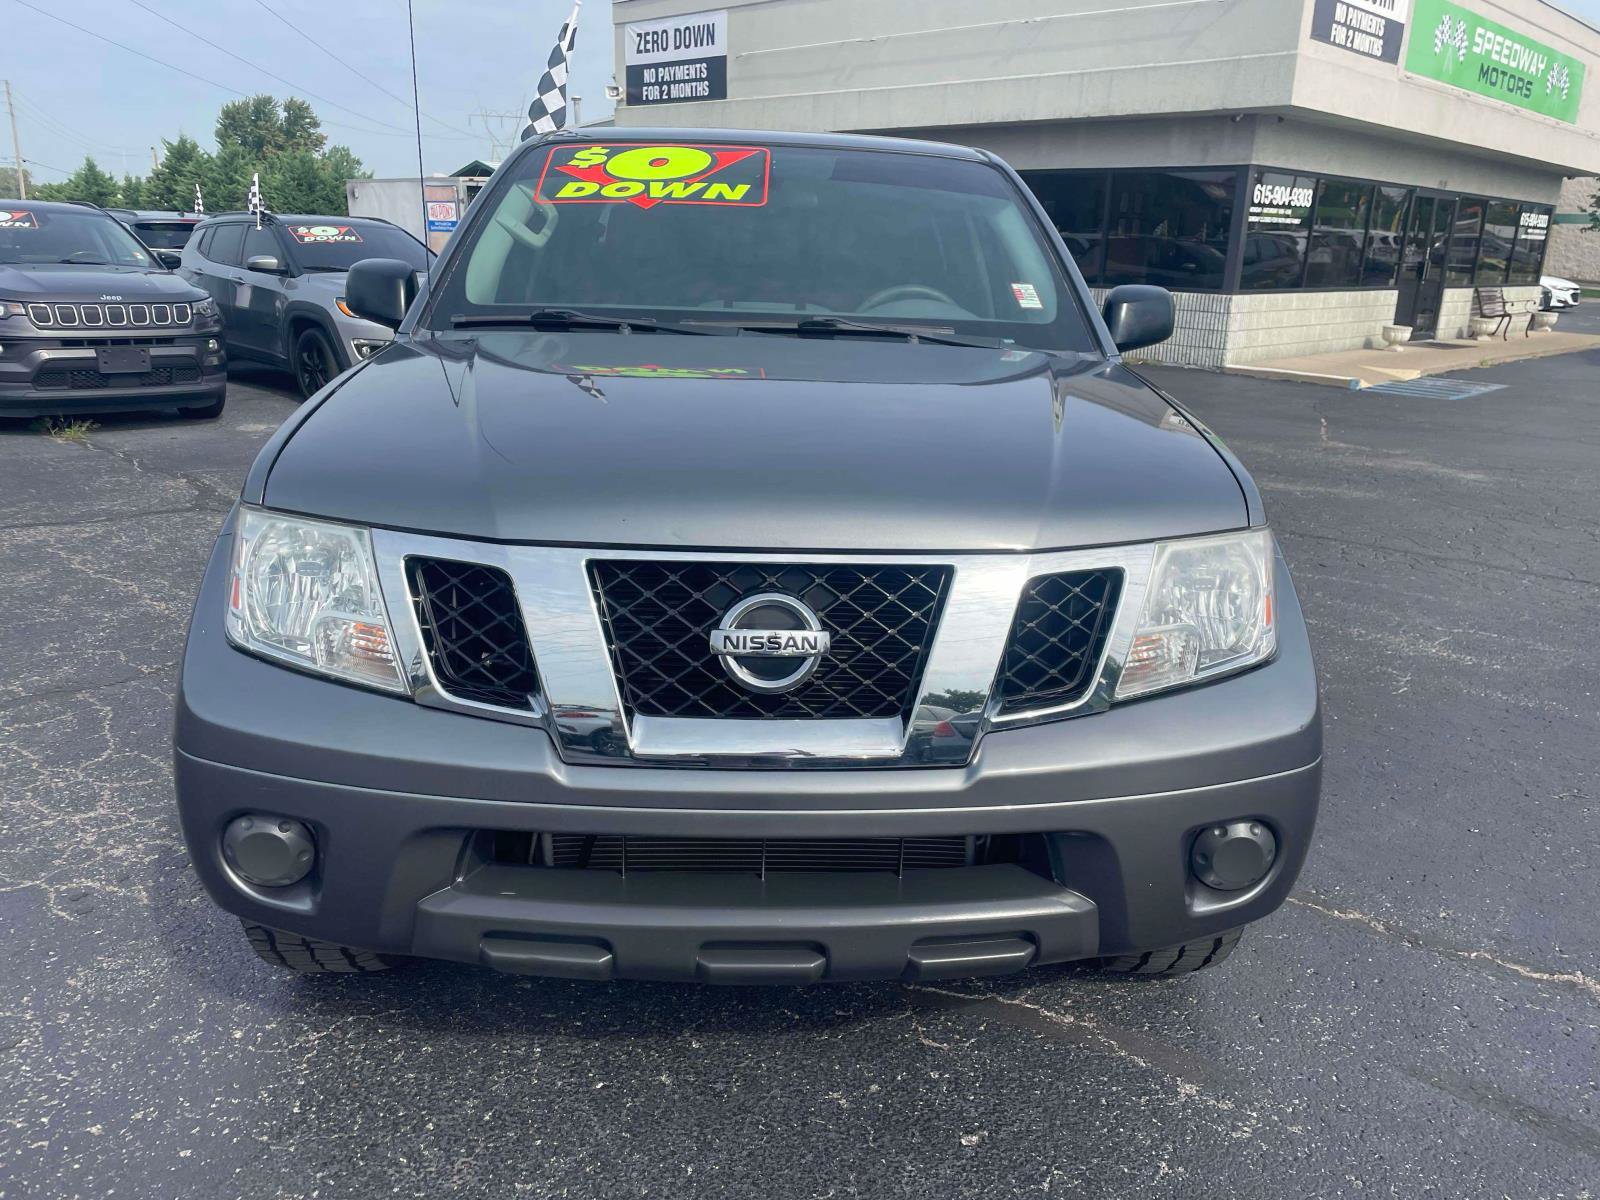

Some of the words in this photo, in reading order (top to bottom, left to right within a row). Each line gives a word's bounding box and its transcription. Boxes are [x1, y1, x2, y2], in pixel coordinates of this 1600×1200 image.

[1334, 2, 1347, 23] NO
[1346, 7, 1386, 37] PAYMENTS
[636, 29, 669, 54] ZERO
[674, 23, 715, 50] DOWN
[1330, 23, 1347, 46] FOR
[1345, 30, 1354, 48] 2
[1352, 31, 1384, 57] MONTHS
[1472, 27, 1548, 78] SPEEDWAY
[643, 68, 656, 84] NO
[658, 63, 708, 82] PAYMENTS
[1478, 63, 1533, 99] MOTORS
[642, 86, 661, 100] FOR
[662, 84, 669, 99] 2
[670, 81, 709, 99] MONTHS
[567, 146, 712, 181] $0
[555, 181, 751, 200] DOWN
[1253, 184, 1313, 207] 615-904-9303
[723, 635, 818, 650] NISSAN
